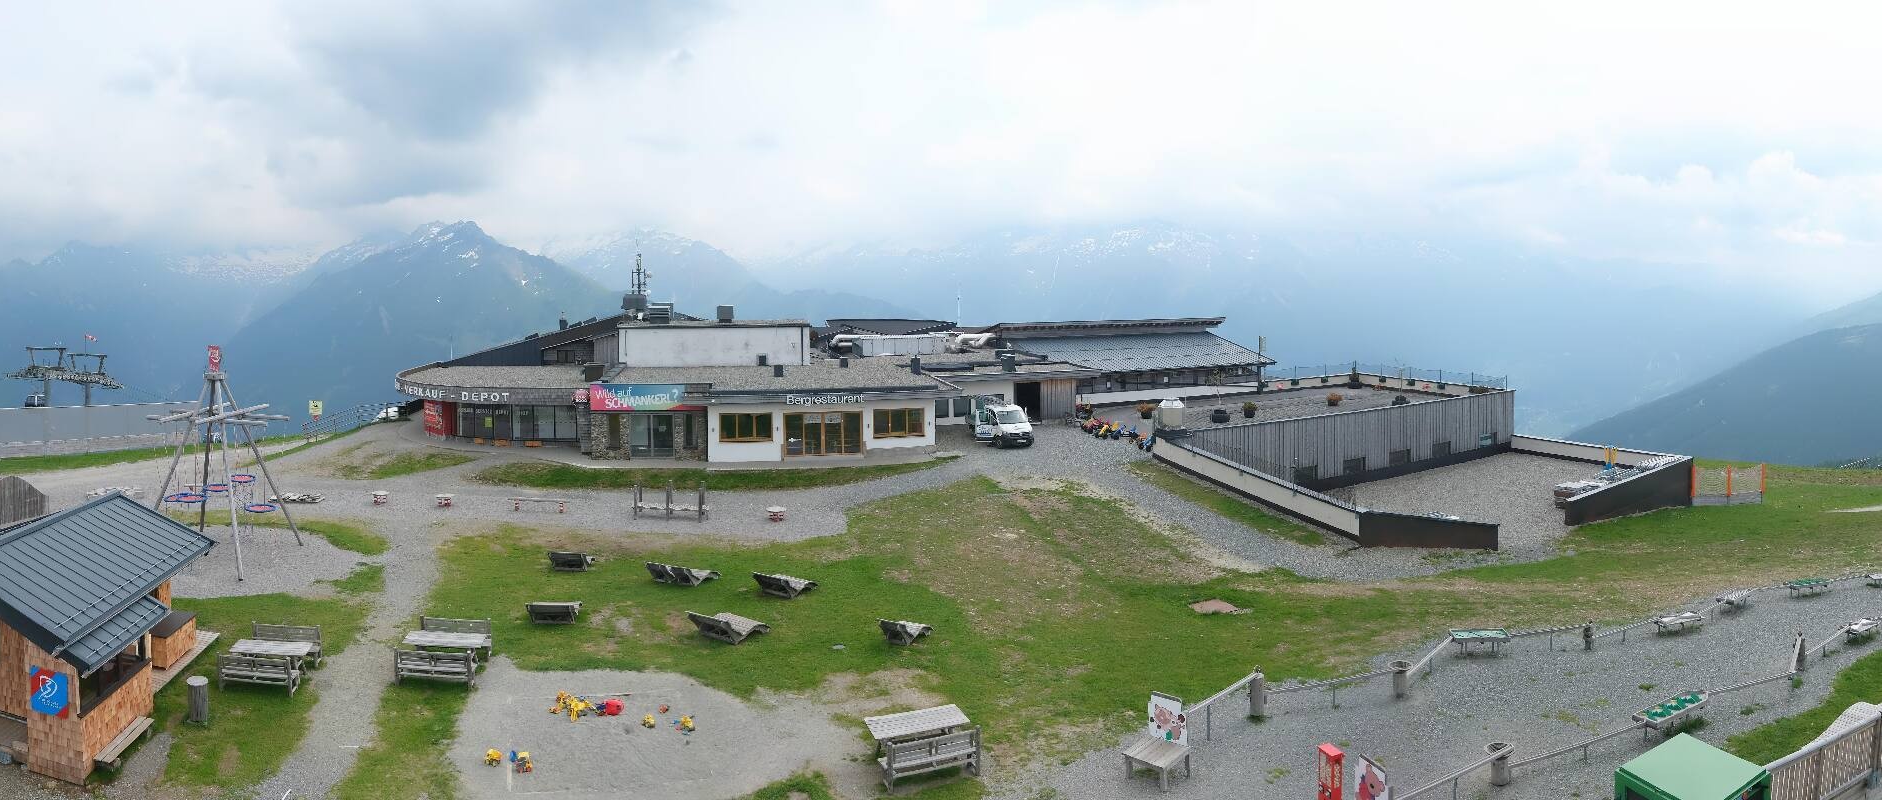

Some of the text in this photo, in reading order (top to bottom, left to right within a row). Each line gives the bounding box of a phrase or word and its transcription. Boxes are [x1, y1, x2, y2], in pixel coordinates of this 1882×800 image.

[404, 385, 446, 399] VERKAUF
[461, 391, 510, 402] DEPOT
[595, 388, 615, 399] Wild
[617, 386, 633, 397] auf
[786, 393, 865, 407] Bergrestaurant
